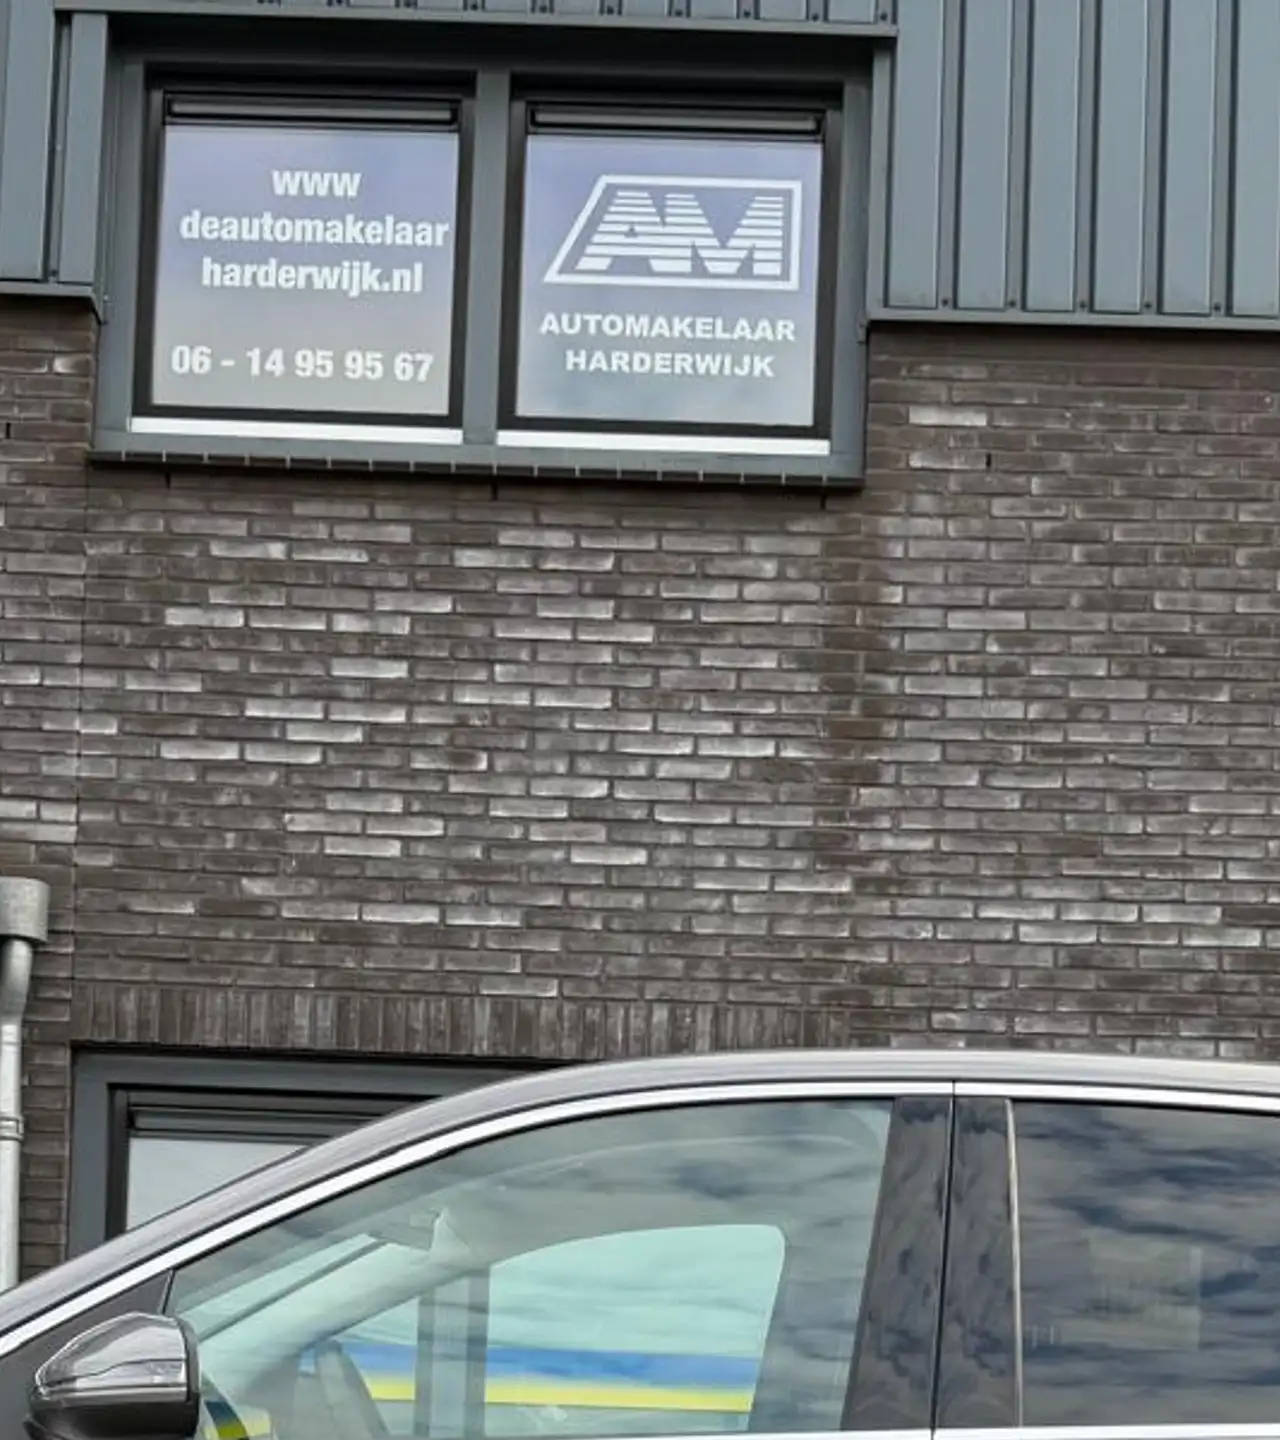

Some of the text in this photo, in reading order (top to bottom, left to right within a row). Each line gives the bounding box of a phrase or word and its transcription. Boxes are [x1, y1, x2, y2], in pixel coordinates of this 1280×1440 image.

[272, 169, 361, 198] www
[180, 210, 449, 248] deautomakelaar
[576, 191, 784, 276] AM
[201, 258, 423, 298] harderwijk.nl
[540, 313, 796, 343] AUTOMAKELAAR
[171, 345, 212, 376] 06
[246, 347, 284, 378] 14
[294, 348, 333, 380] 95
[344, 350, 383, 381] 95
[394, 352, 433, 383] 67
[565, 348, 775, 379] HARDERWIJK
